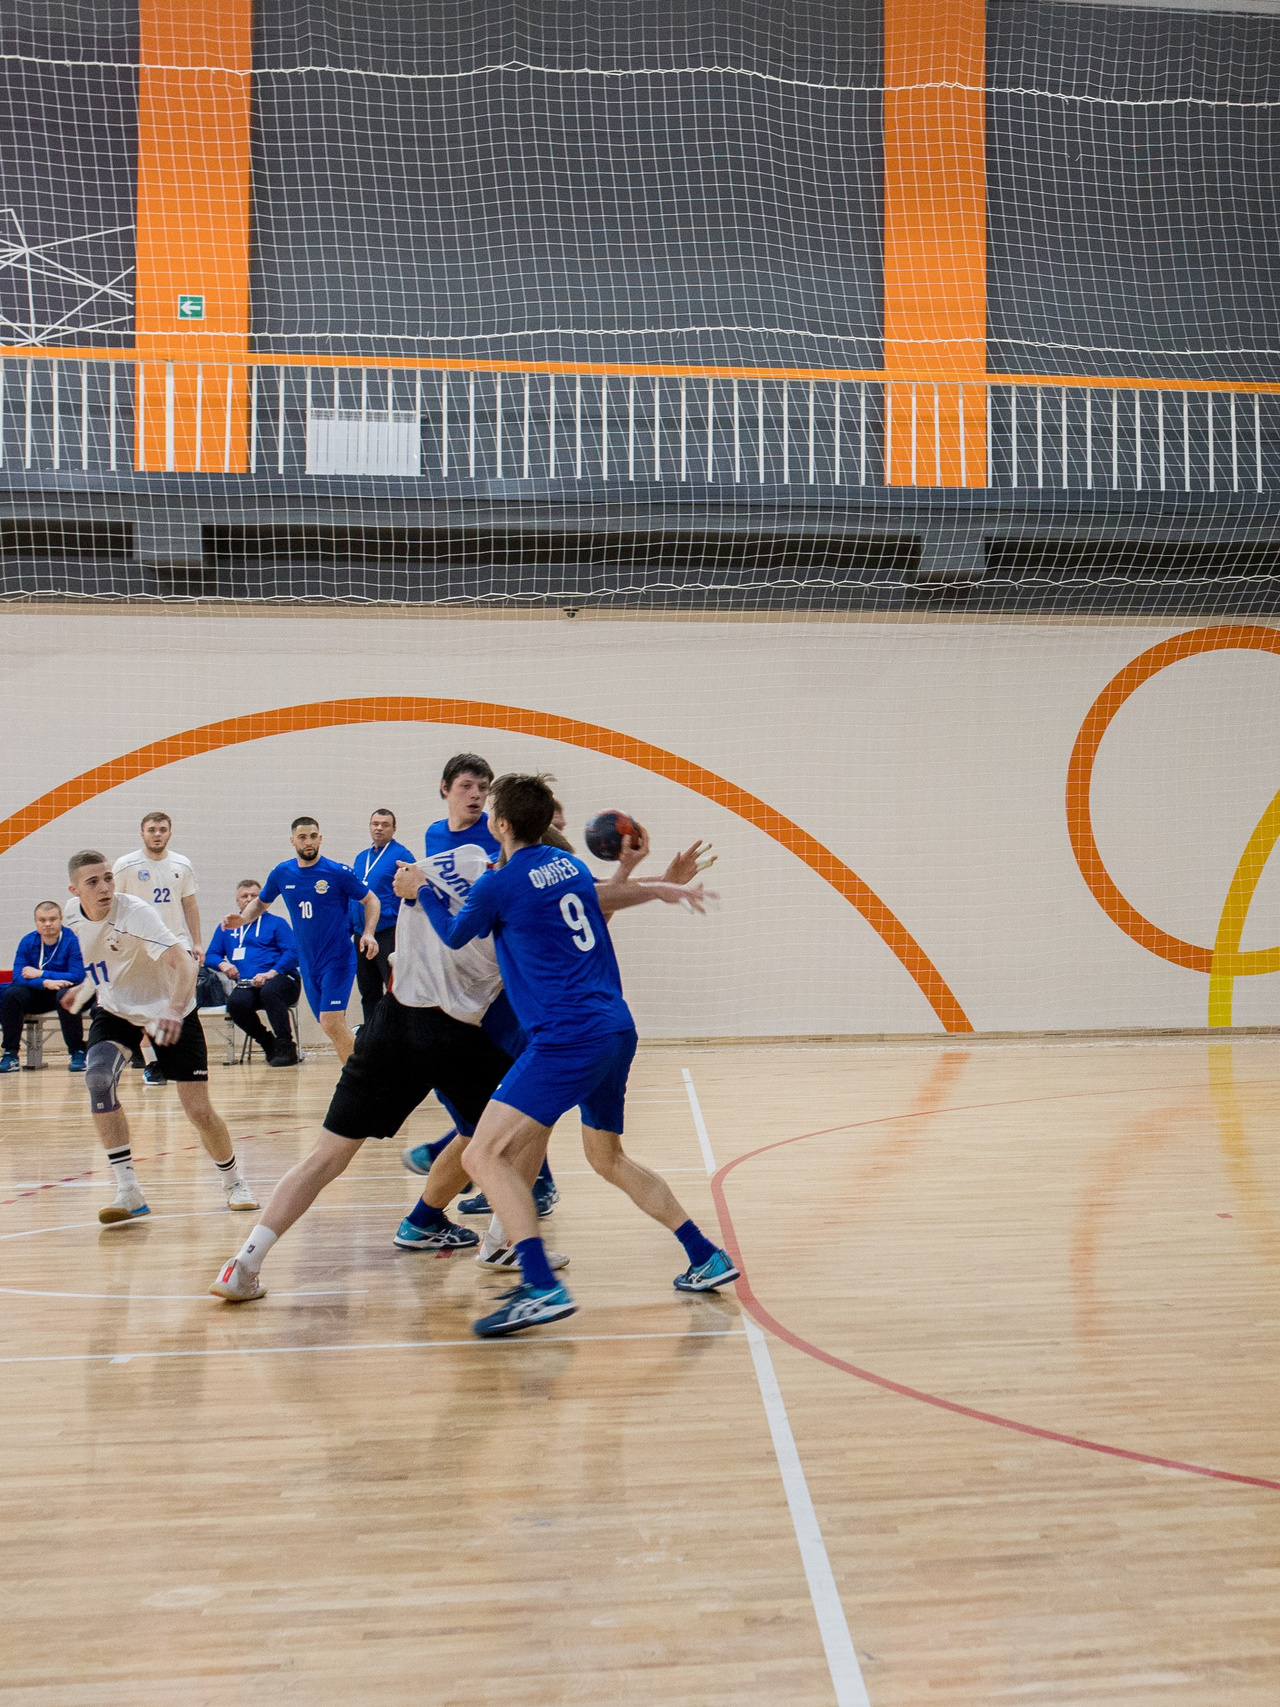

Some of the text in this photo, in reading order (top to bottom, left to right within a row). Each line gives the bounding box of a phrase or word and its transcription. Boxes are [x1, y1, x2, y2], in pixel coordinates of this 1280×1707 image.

[528, 856, 580, 890] ФИЛЁВ
[153, 887, 171, 903] 22
[298, 901, 313, 919] 10
[559, 892, 596, 952] 9
[84, 960, 110, 986] 11
